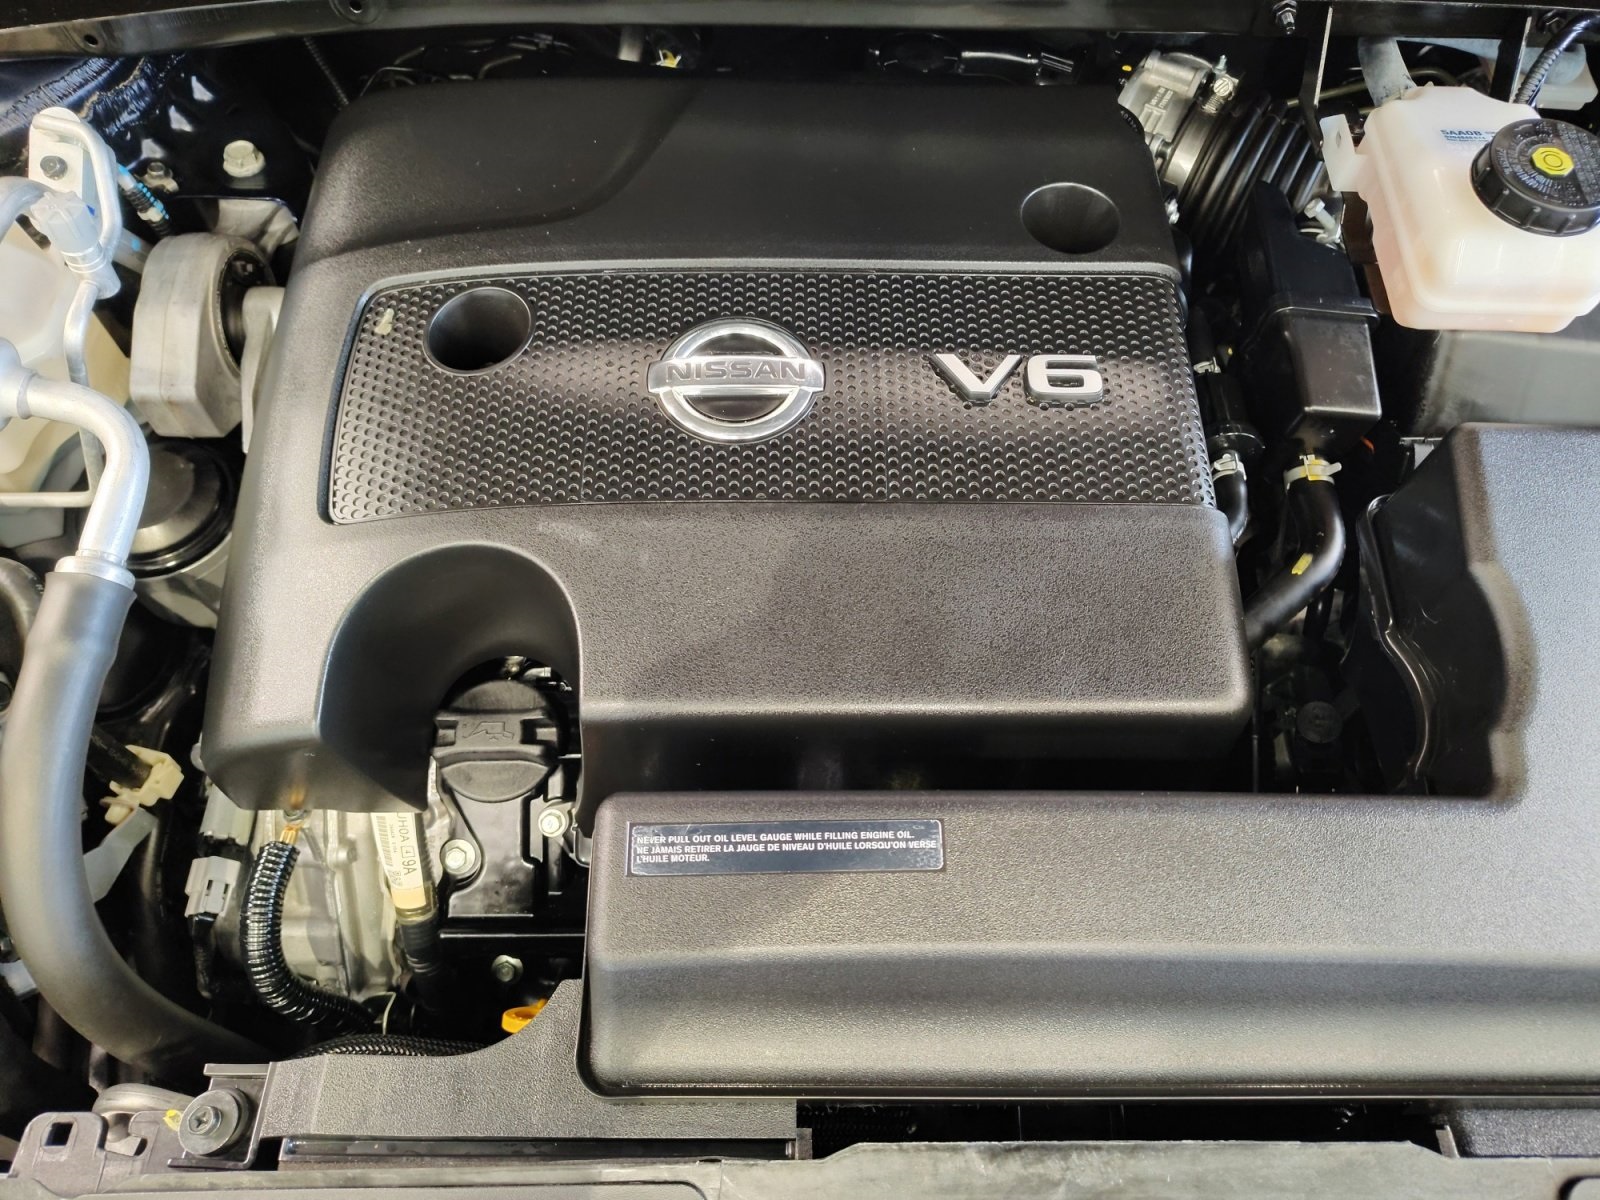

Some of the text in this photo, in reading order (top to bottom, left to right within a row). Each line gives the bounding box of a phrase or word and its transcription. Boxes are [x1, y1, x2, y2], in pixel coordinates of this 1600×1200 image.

[666, 360, 806, 382] NISSAN
[929, 352, 1104, 404] V6
[636, 830, 915, 844] NEVER PULL OUT OIL LEVEL GAUGE WHILE FILLING ENGINE OIL.
[636, 840, 937, 854] NE JAMAIS RETIRER LA JAUGE DE NIVEAU D'HUILE LORSQU'ON VERSE
[636, 854, 710, 863] L'HUILE MOTEUR.
[401, 859, 418, 876] 9A
